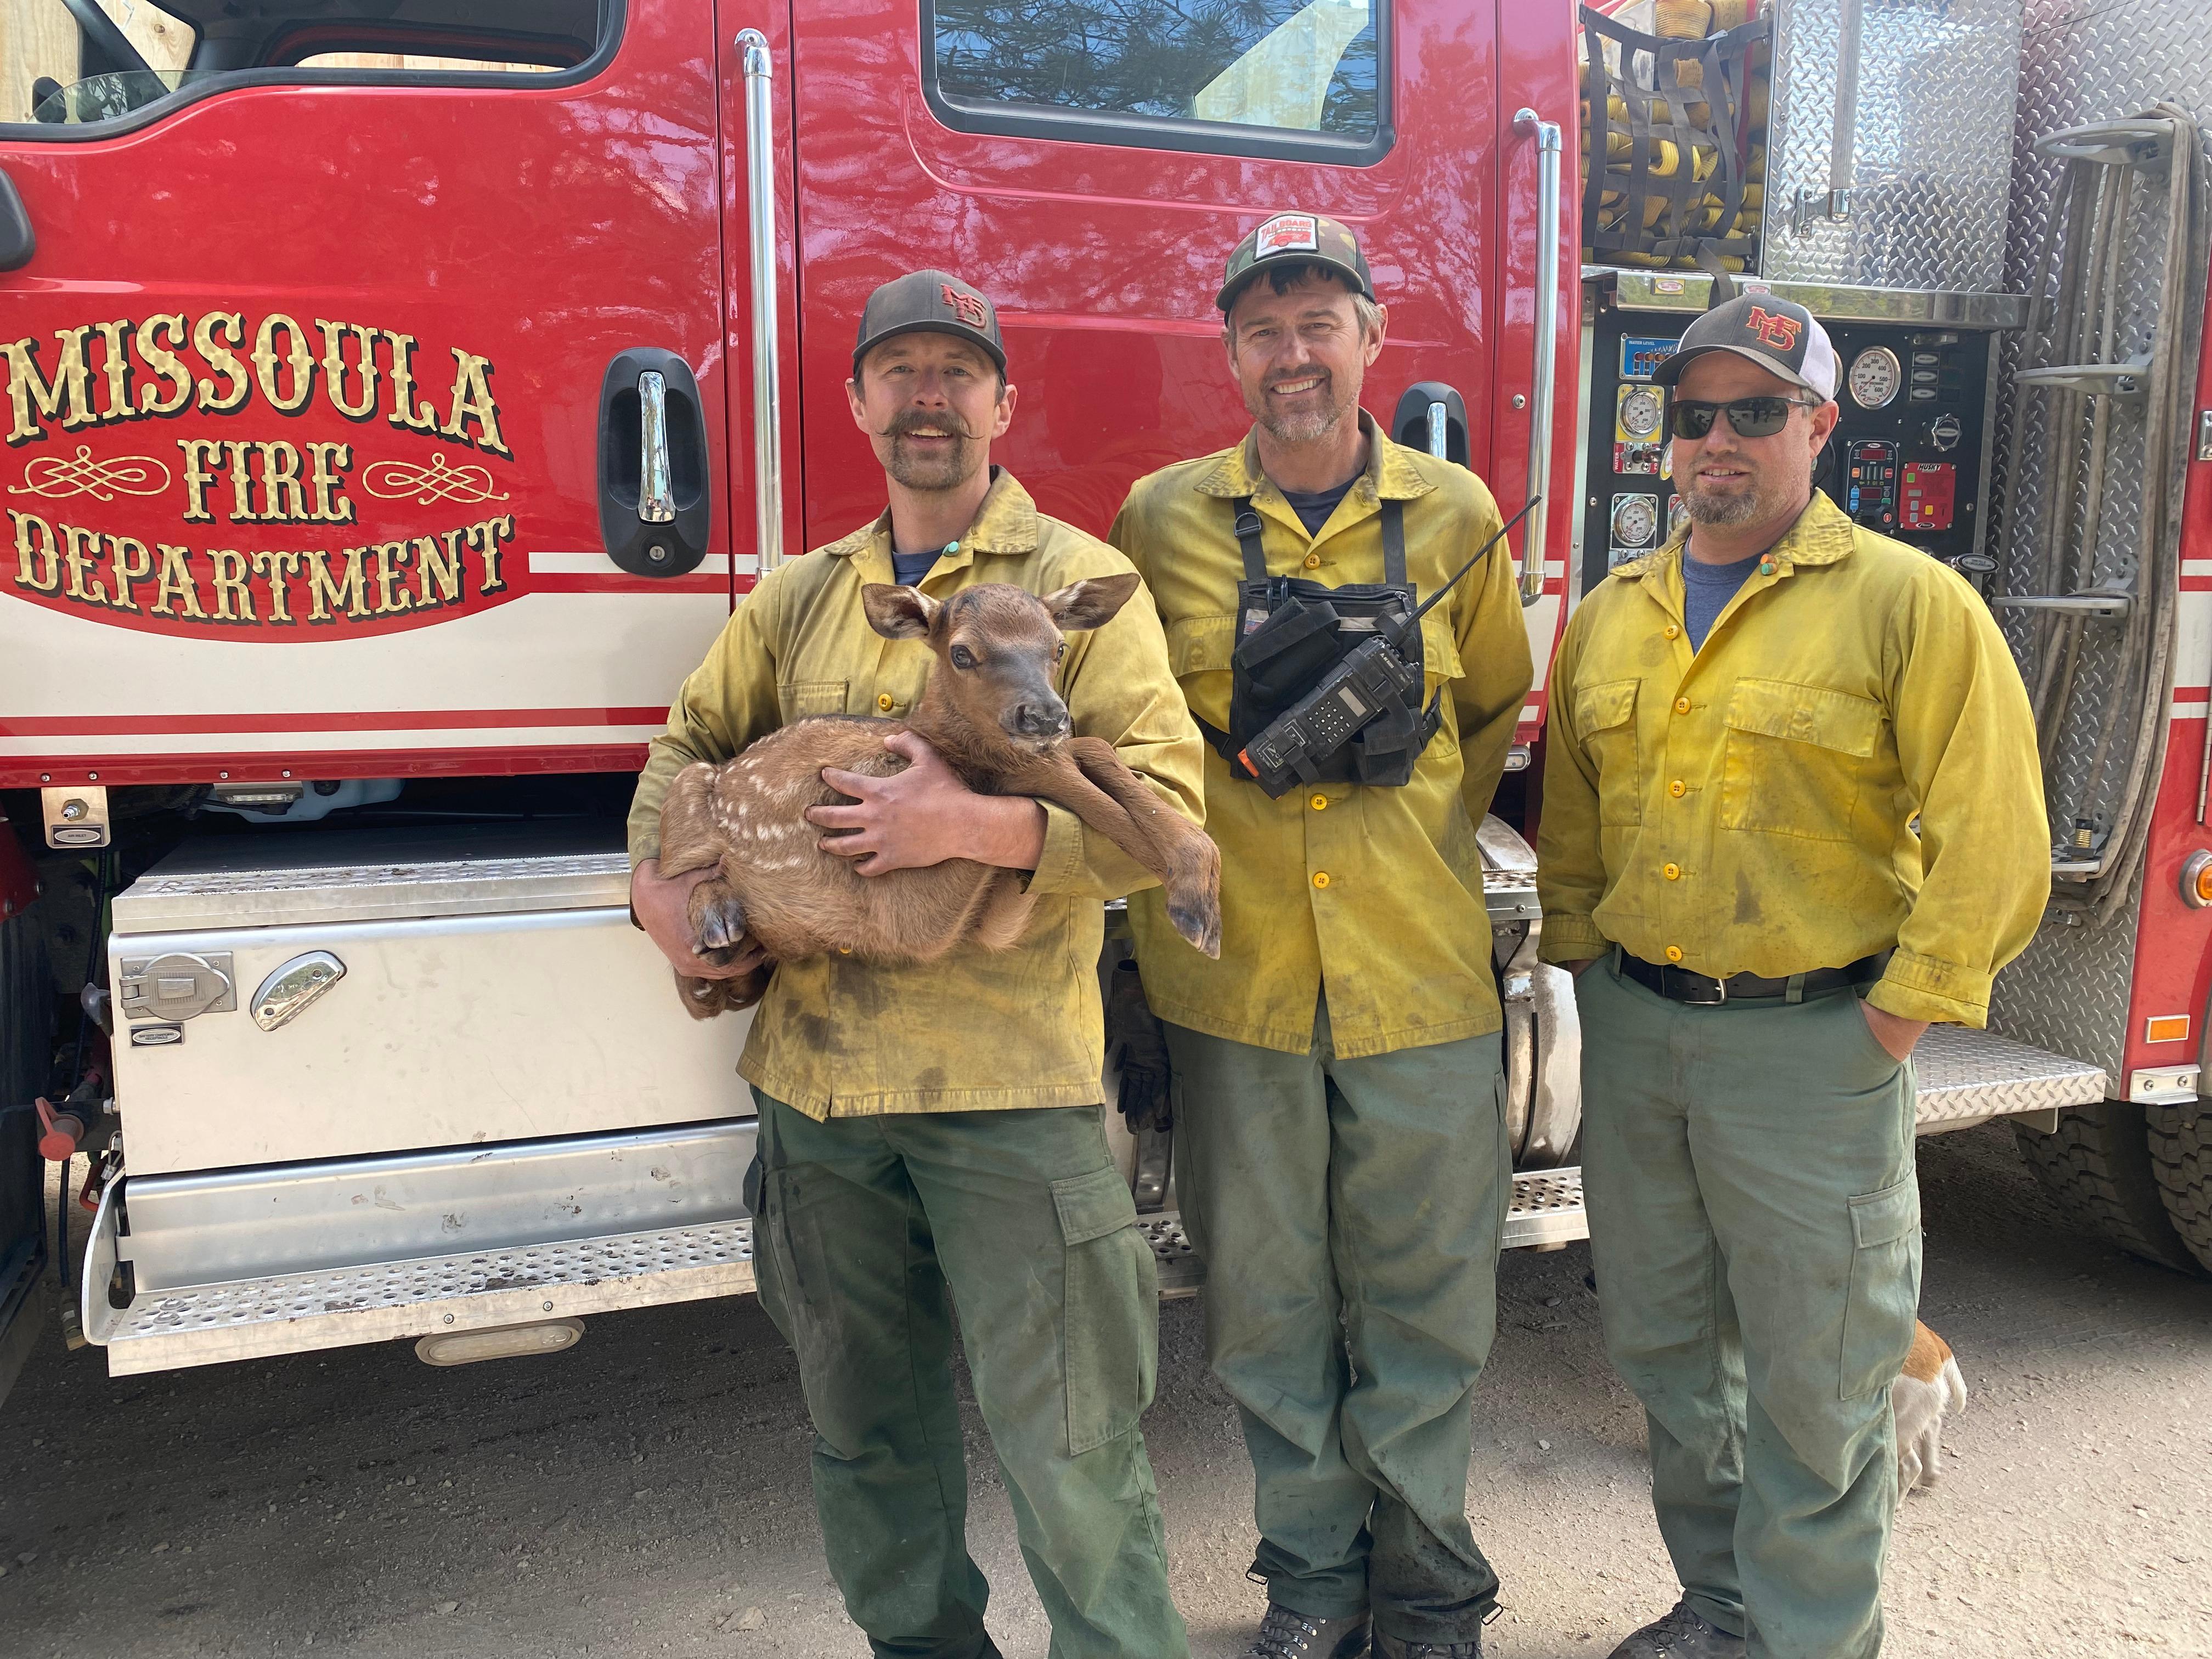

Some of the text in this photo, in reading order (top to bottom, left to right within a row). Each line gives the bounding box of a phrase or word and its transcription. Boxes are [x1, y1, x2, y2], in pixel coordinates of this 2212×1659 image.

[0, 312, 514, 461] MISSOULA
[177, 439, 357, 524] FIRE
[6, 515, 514, 625] DEPARTMENT
